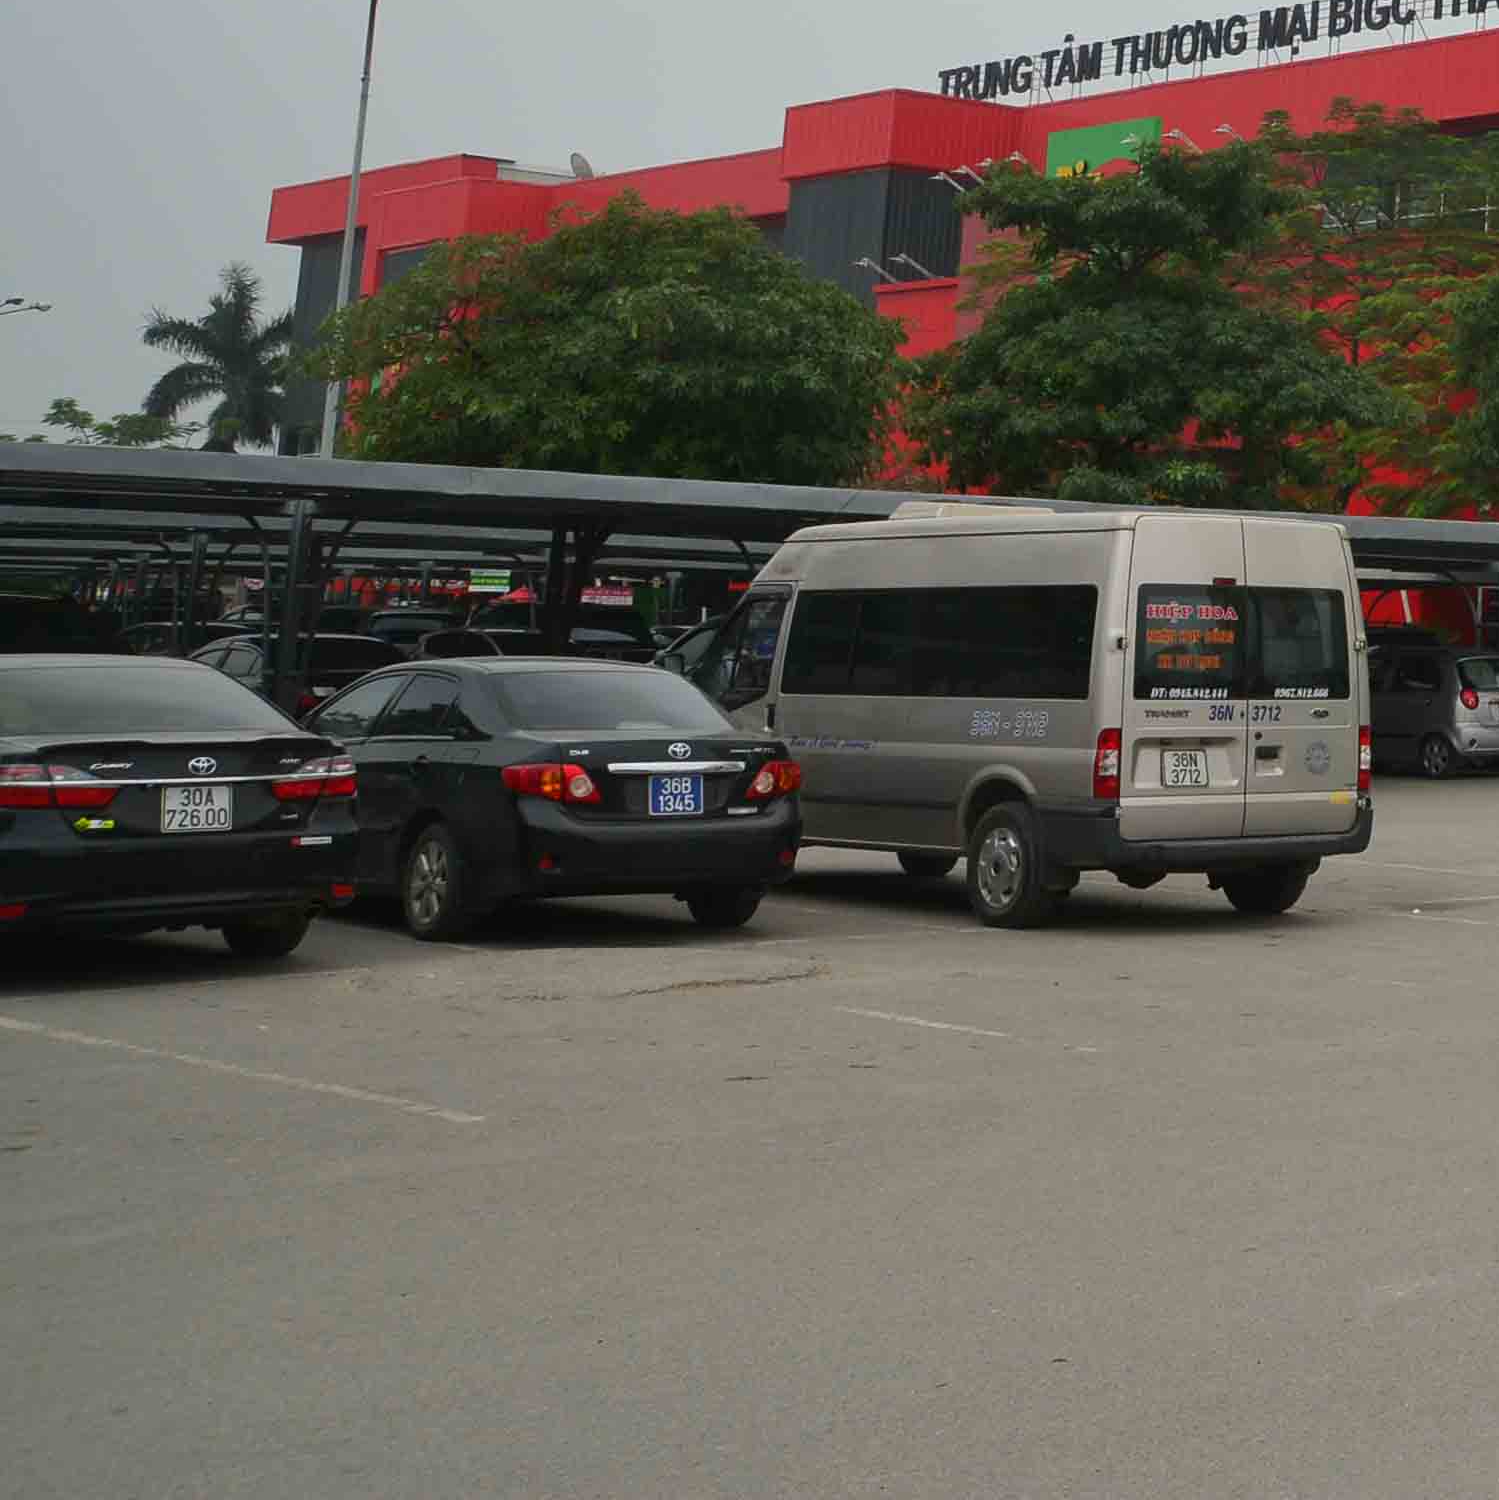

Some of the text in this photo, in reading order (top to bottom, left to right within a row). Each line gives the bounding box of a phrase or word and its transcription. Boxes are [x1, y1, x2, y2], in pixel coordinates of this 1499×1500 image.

[938, 55, 1033, 100] TRUNG
[1041, 34, 1104, 88] TÂM
[1111, 14, 1248, 76] THƯƠNG
[1257, 0, 1320, 55] MẠI
[1208, 705, 1281, 721] 36N 3712
[1172, 753, 1198, 767] 36N
[1171, 770, 1201, 784] 3712
[661, 778, 691, 795] 36B
[180, 787, 214, 807] 30A
[658, 796, 695, 813] 1345
[165, 808, 228, 829] 726.00
